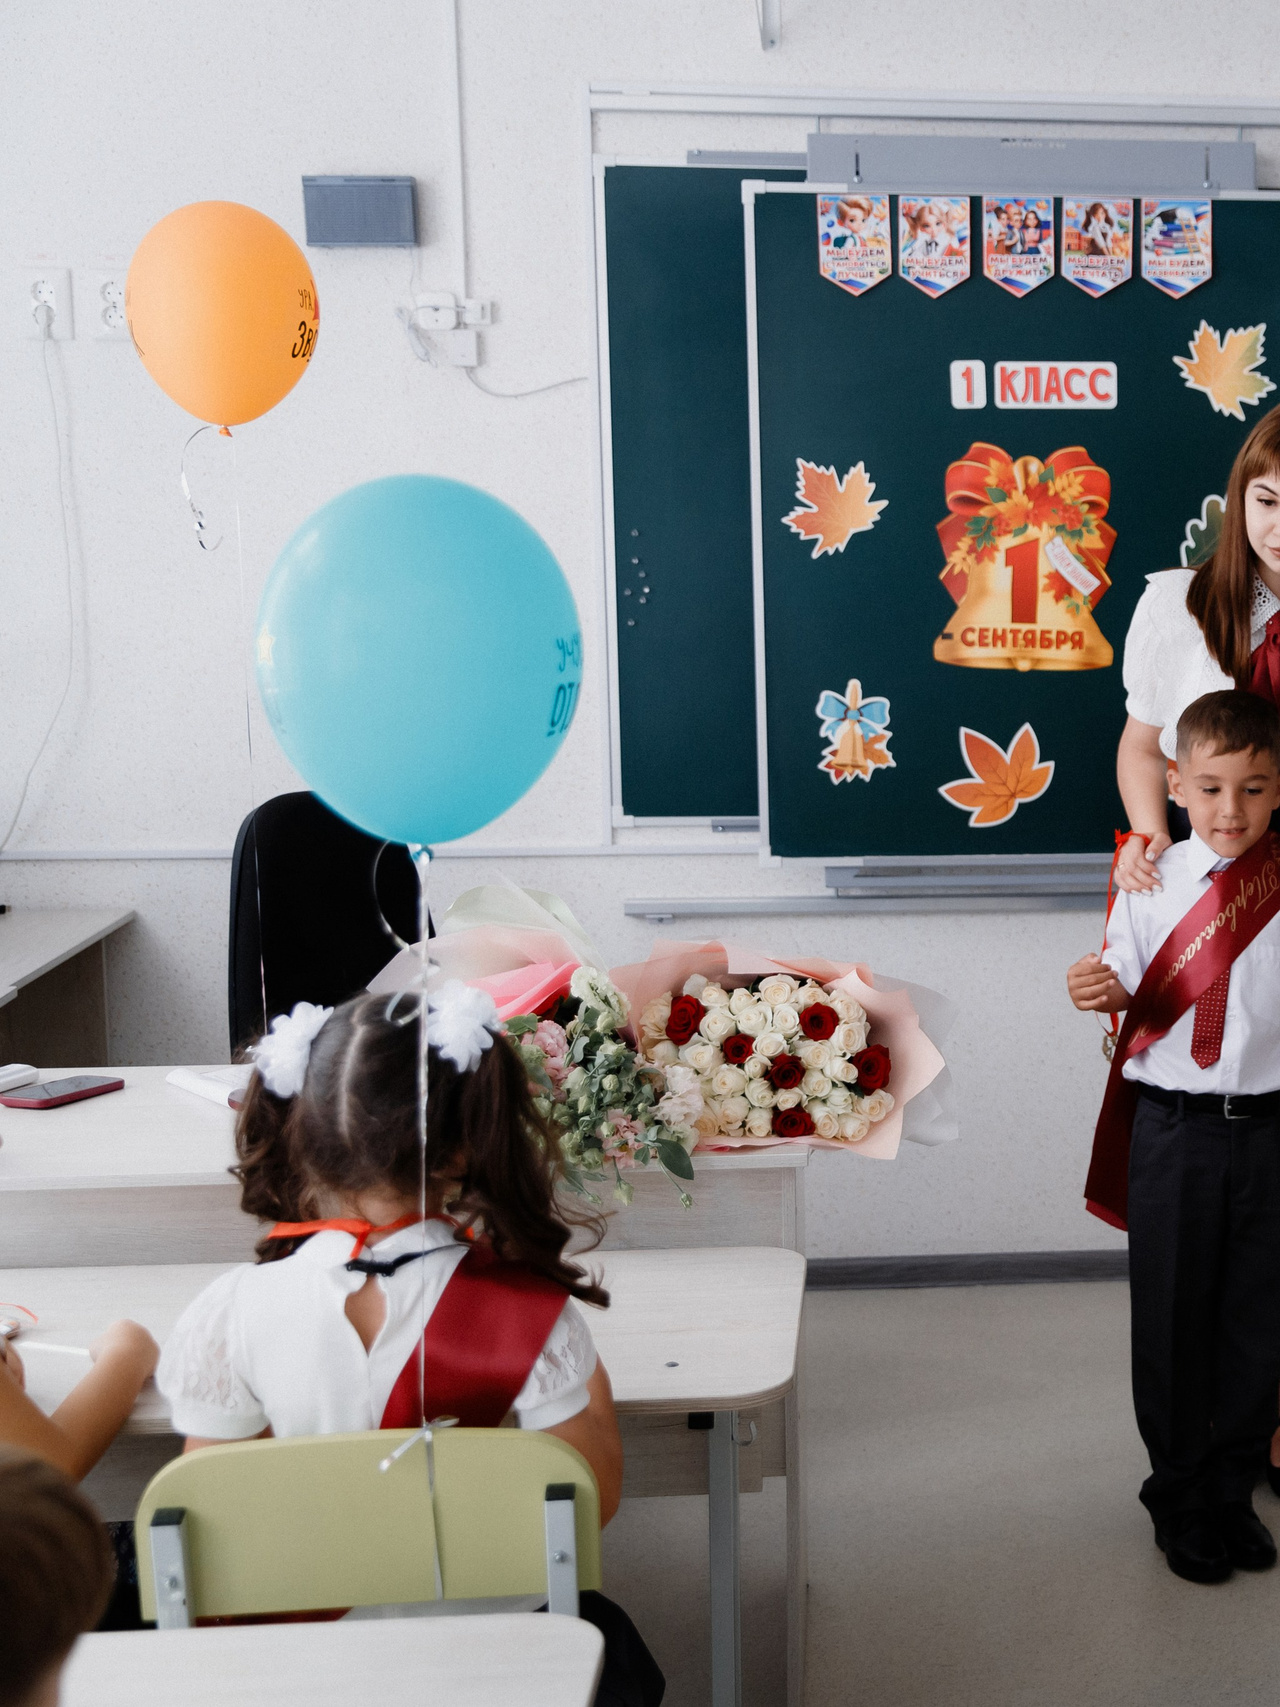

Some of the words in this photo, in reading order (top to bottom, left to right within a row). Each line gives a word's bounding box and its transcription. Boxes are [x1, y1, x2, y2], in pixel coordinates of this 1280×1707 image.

[826, 249, 845, 257] МЫ
[848, 249, 885, 258] БУДЕМ
[906, 258, 924, 266] МЫ
[927, 258, 964, 267] БУДЕМ
[990, 257, 1008, 265] МЫ
[1011, 257, 1048, 266] БУДЕМ
[1067, 257, 1086, 265] МЫ
[1088, 257, 1125, 266] БУДЕМ
[1169, 260, 1205, 268] БУДЕМ
[837, 270, 875, 279] ЛУЧШЕ
[911, 270, 959, 279] УЧИТЬСЯ
[993, 268, 1046, 277] ДРУЖИТЬ
[961, 366, 974, 404] 1
[1000, 366, 1112, 403] КЛАСС
[1005, 538, 1040, 624] 1
[960, 627, 1086, 651] СЕНТЯБРЯ
